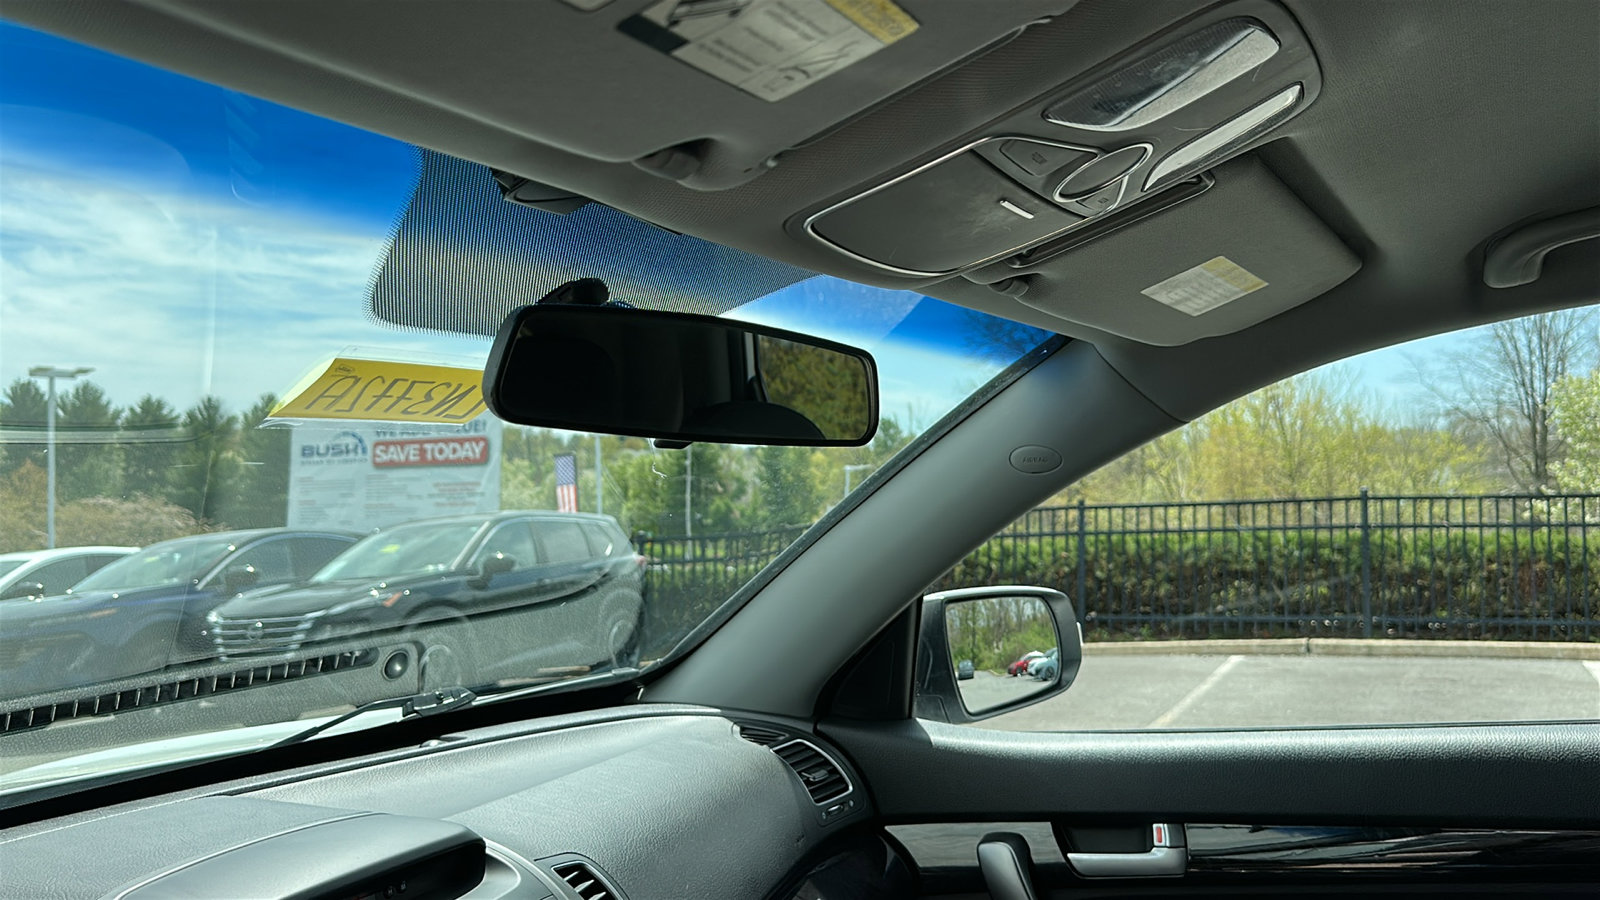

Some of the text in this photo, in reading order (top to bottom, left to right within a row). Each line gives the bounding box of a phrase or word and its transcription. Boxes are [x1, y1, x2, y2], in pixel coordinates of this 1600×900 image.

[301, 444, 359, 458] BUSH
[375, 441, 485, 463] SAVE TODAY
